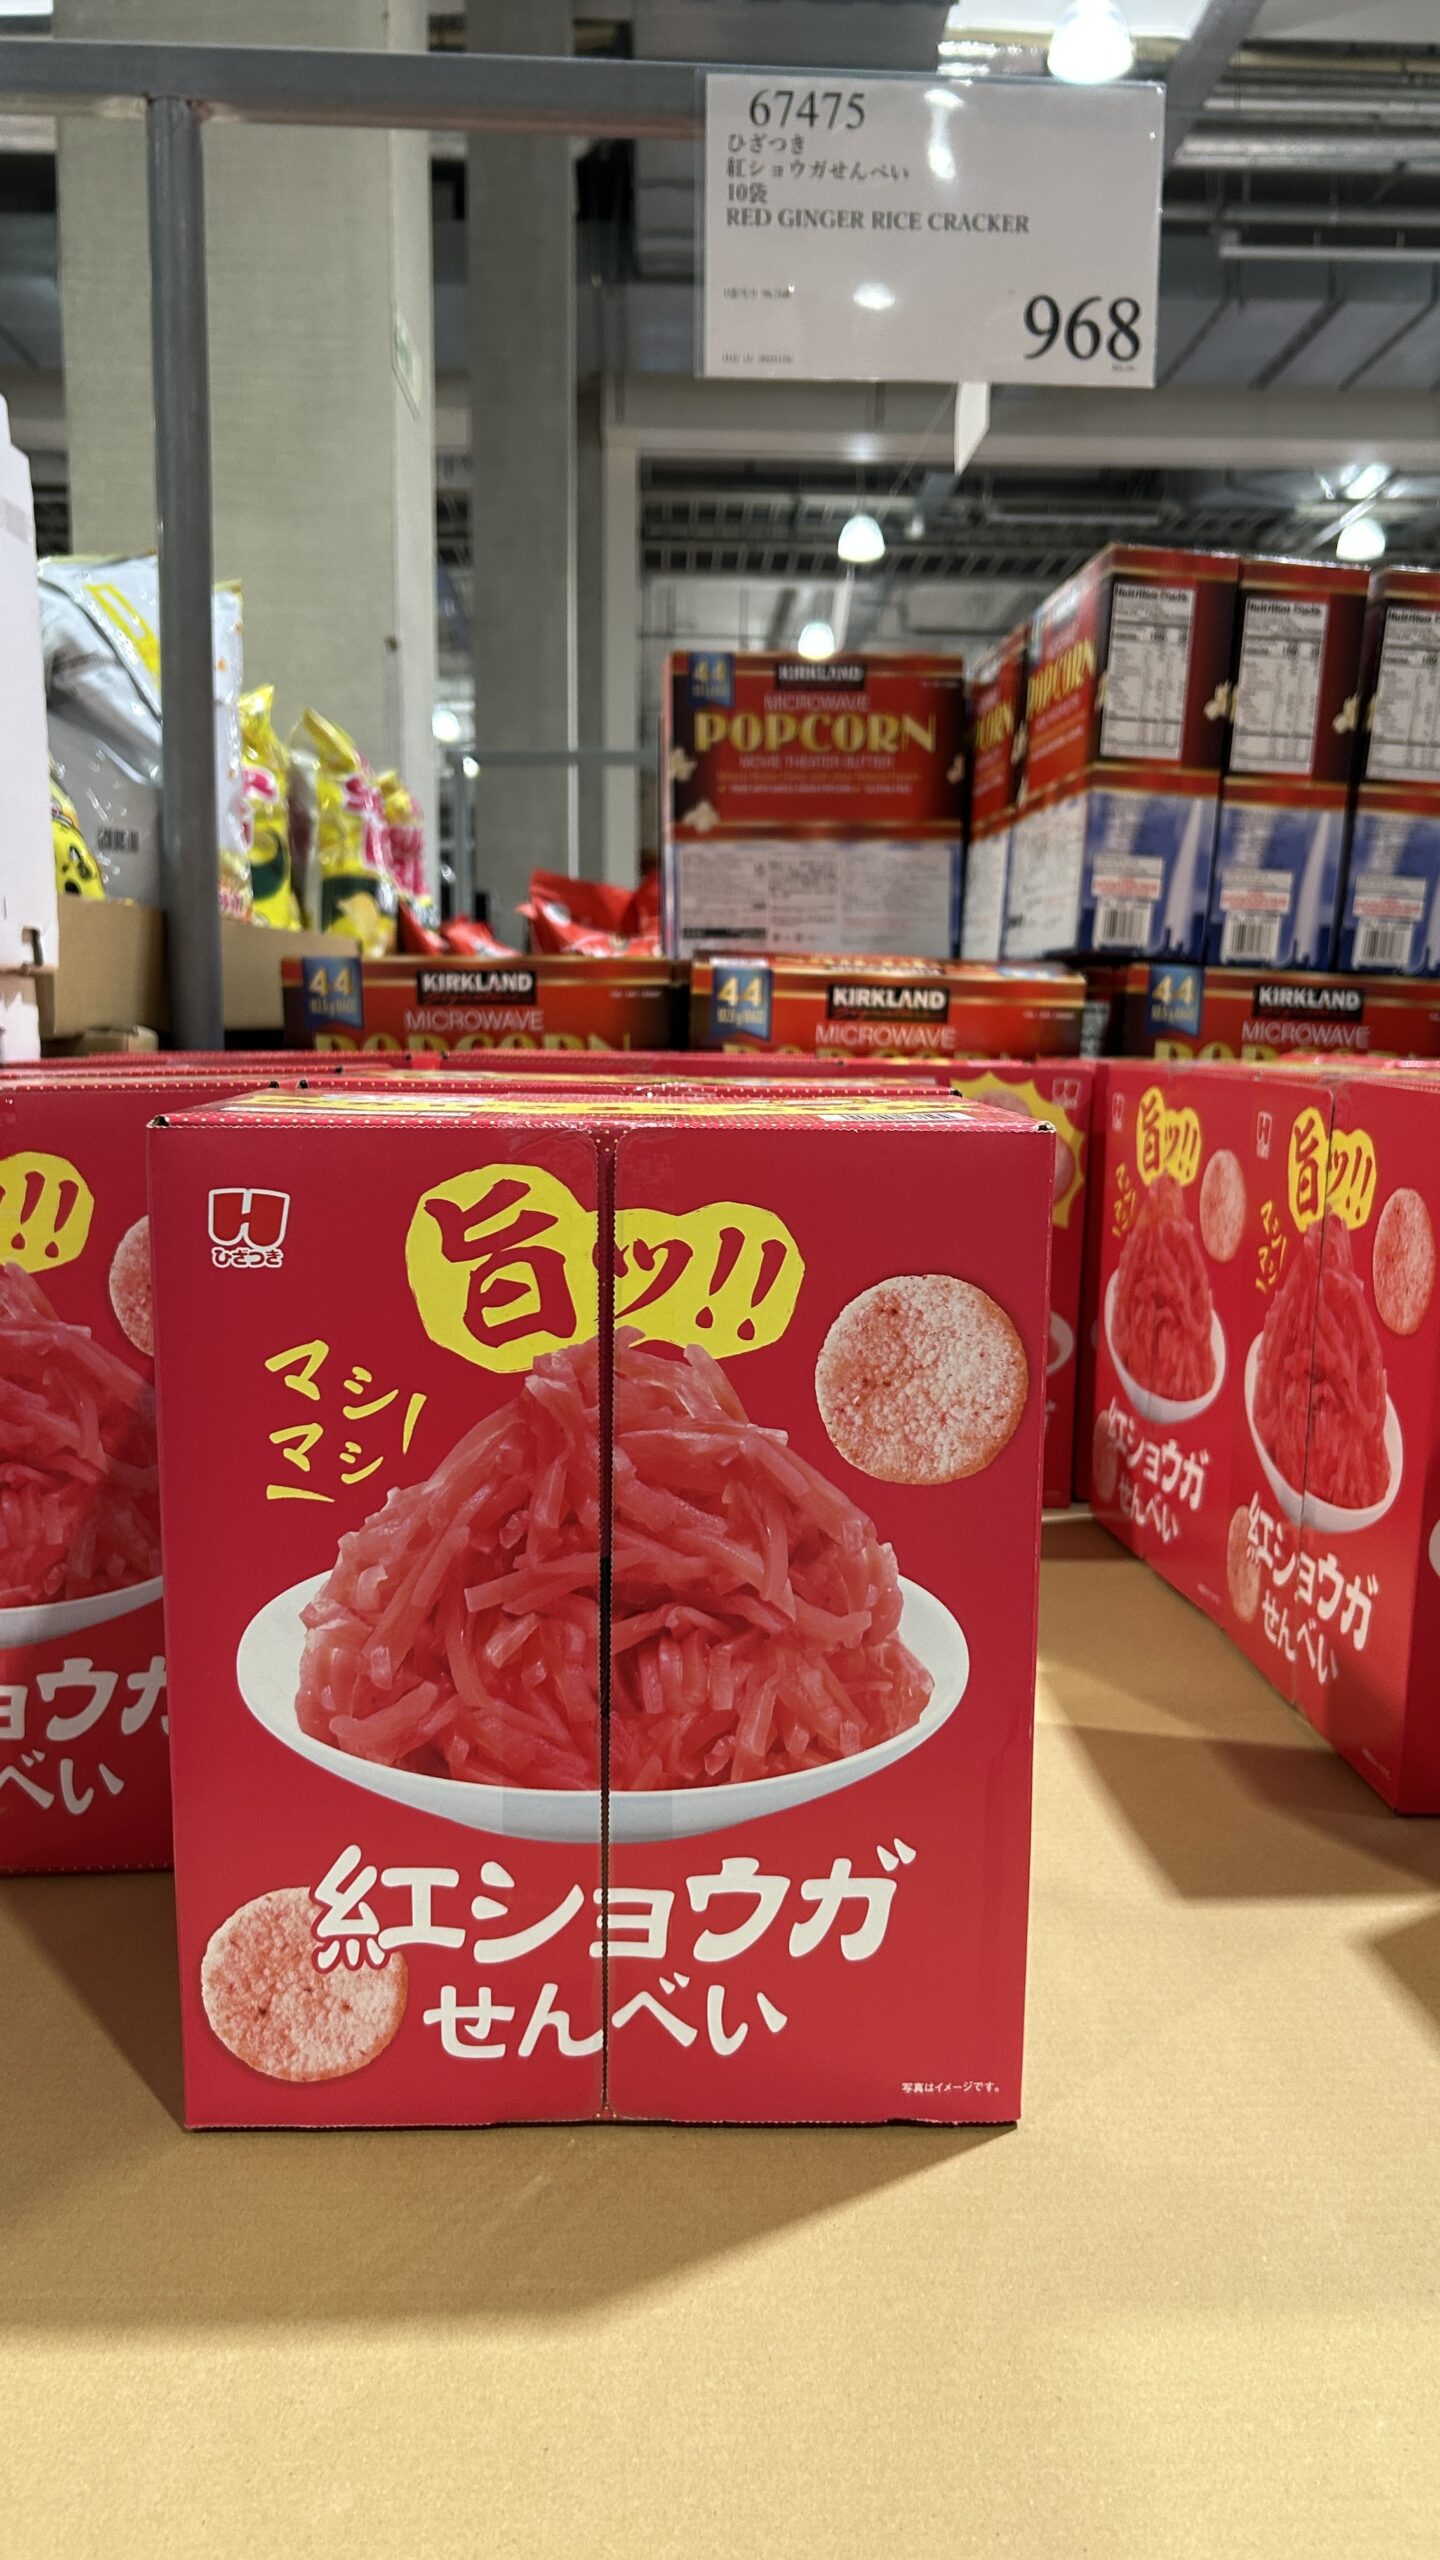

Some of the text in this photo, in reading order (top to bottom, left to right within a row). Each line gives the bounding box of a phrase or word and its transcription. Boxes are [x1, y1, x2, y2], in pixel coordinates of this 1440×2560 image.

[749, 89, 866, 130] 67475
[727, 133, 805, 154] ひざつき
[726, 157, 910, 181] 紅ショウガせんべい
[727, 183, 768, 203] 10袋
[726, 208, 1030, 233] RED GINGER RICE CRACKER
[1023, 294, 1142, 362] 968
[777, 664, 865, 681] KIRKLAND
[764, 694, 870, 712] MICROWAVE
[694, 712, 937, 753] POPCORN
[309, 967, 353, 997] 44
[421, 973, 534, 993] KIRKLAND
[718, 976, 763, 1007] 44
[1152, 975, 1196, 1004] 44
[833, 987, 946, 1010] KIRKLAND
[1258, 986, 1362, 1012] KIRKLAND
[404, 1009, 544, 1032] MICROWAVE
[816, 1024, 957, 1049] MICROWAVE
[1242, 1020, 1370, 1048] MICROWAVE
[211, 1246, 284, 1268] ひざつき
[1246, 1490, 1379, 1651] 紅ショウガ
[1261, 1589, 1339, 1685] せんべい
[314, 1838, 917, 1970] 紅ショウガ
[423, 1972, 788, 2059] せんべい
[901, 2081, 1000, 2094] 写真はイメージです。
